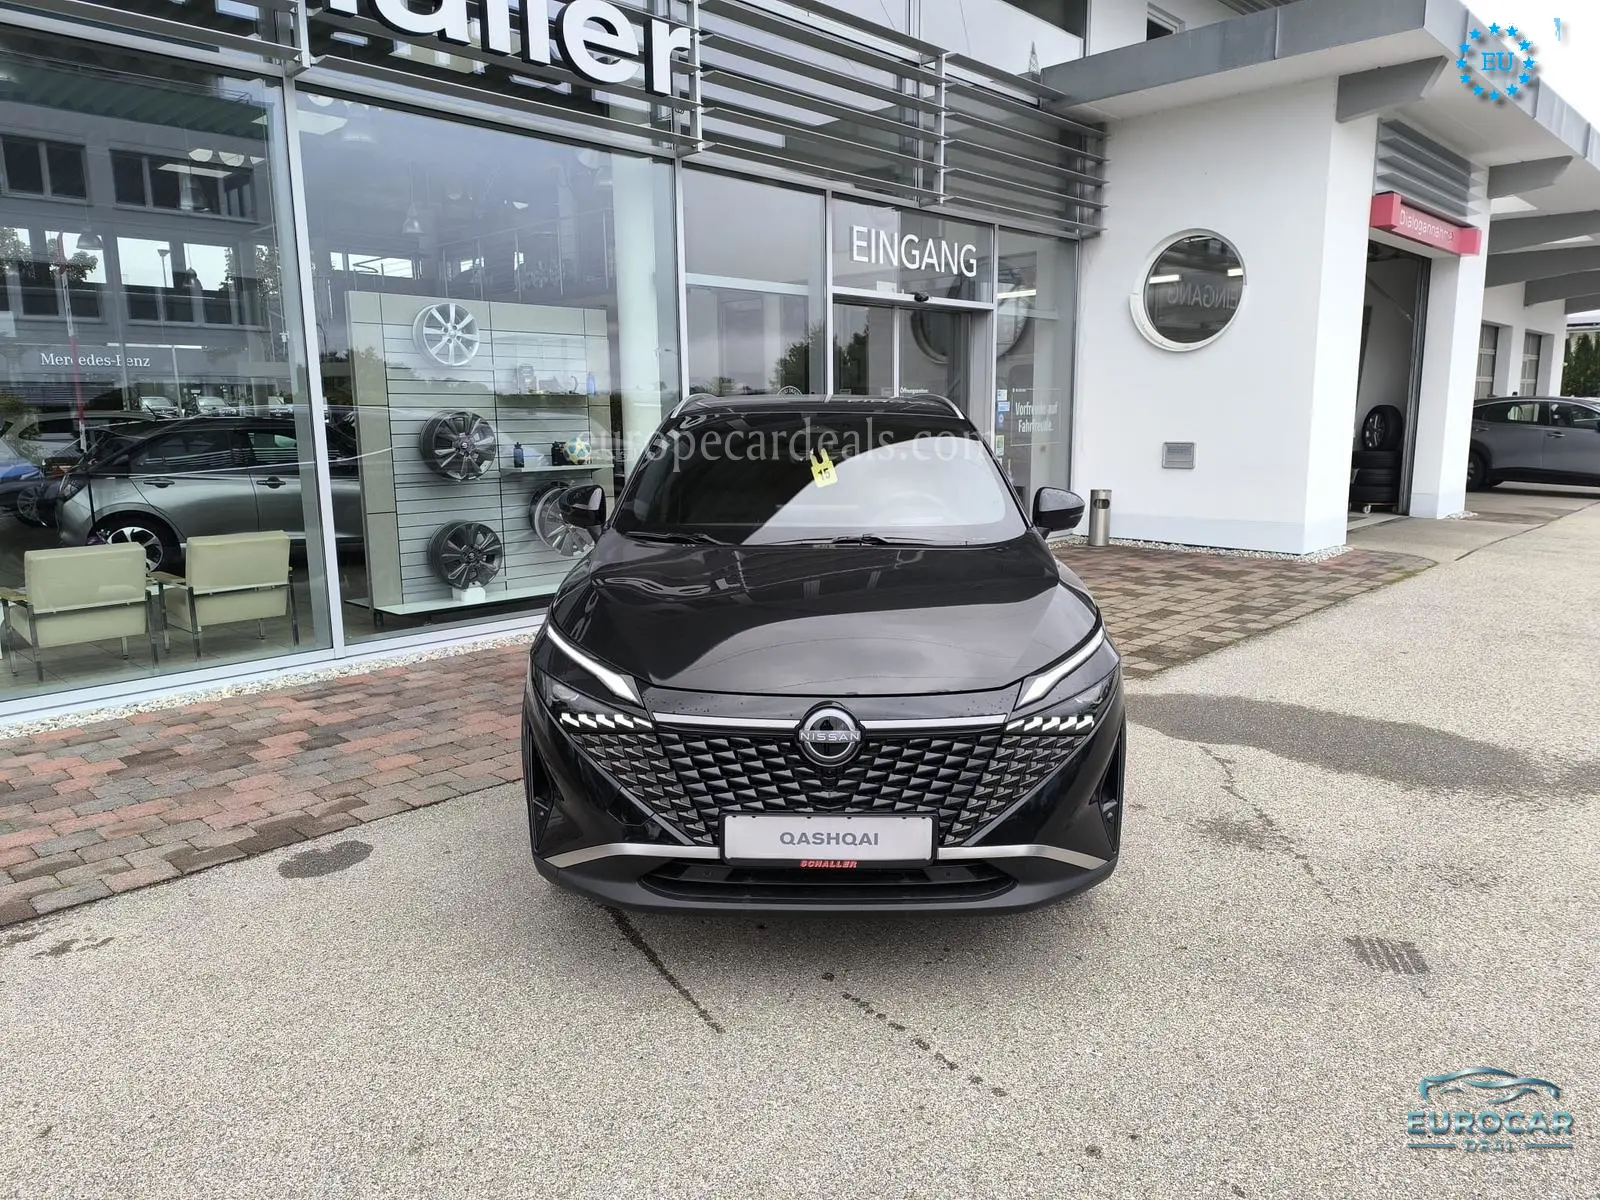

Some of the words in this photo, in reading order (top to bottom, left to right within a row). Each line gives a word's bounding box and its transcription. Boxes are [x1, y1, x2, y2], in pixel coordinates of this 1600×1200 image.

[323, 0, 690, 95] aller
[852, 224, 977, 278] EINGANG
[817, 467, 831, 481] 15
[800, 732, 860, 742] NISSAN
[779, 831, 879, 847] QASHQAI
[800, 859, 858, 869] SCHALLER
